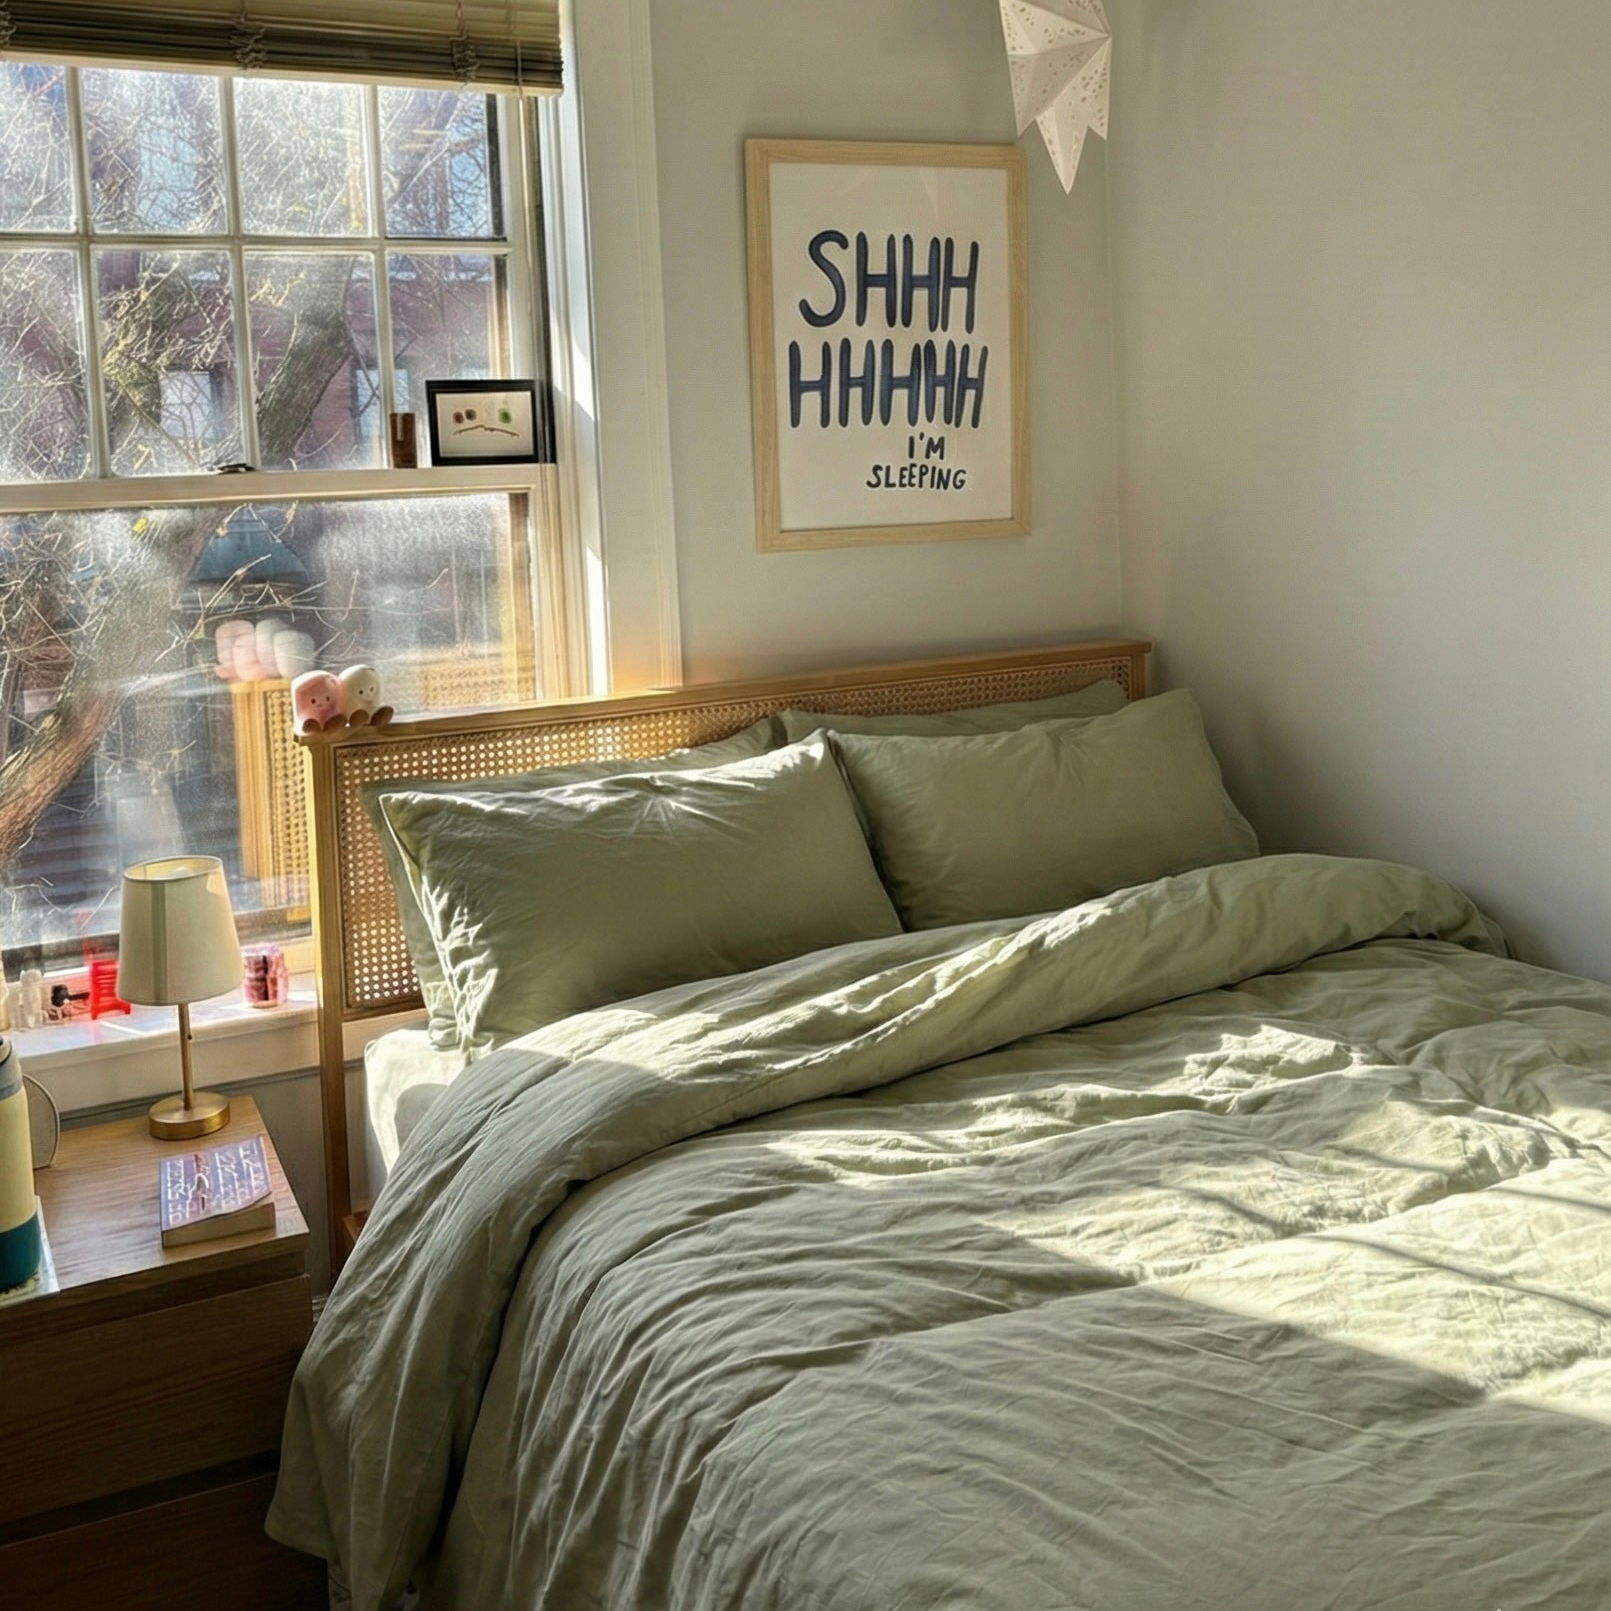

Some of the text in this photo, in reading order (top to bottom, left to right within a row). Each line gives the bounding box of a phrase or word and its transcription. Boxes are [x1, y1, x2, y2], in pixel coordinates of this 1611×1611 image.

[799, 229, 980, 334] SHHH
[789, 337, 989, 429] HHHHH
[908, 432, 945, 460] I'M
[866, 464, 967, 490] SLEEPING
